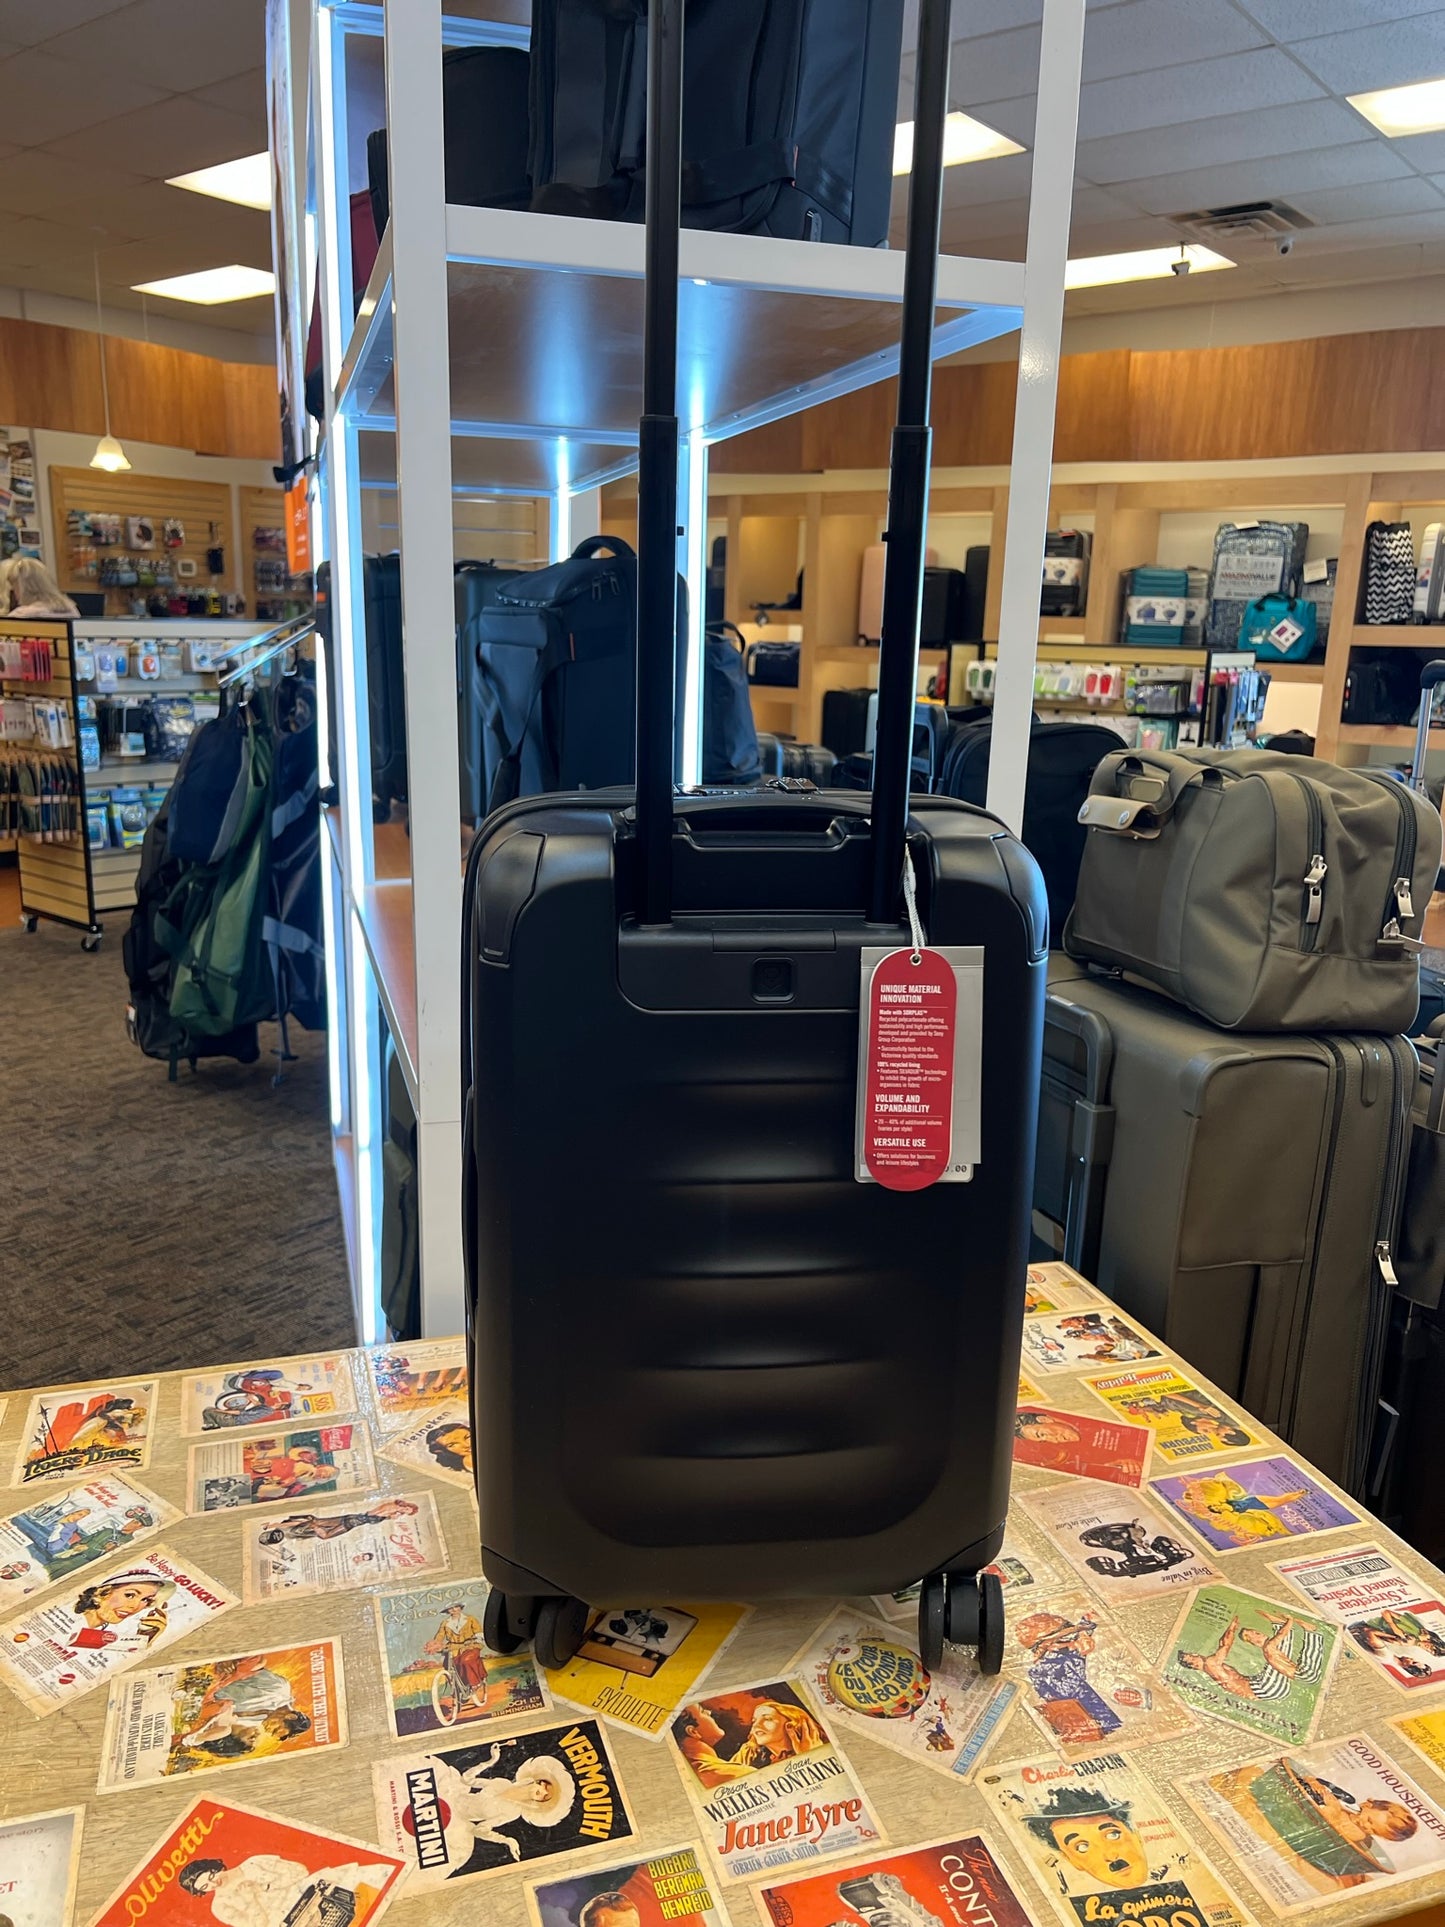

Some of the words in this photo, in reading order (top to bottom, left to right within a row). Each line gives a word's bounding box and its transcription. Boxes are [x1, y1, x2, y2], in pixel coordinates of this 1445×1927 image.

[880, 985, 906, 993] UNIQUE
[908, 985, 942, 993] MATERIAL
[880, 995, 922, 1003] INNOVATION
[875, 1094, 904, 1102] VOLUME
[906, 1095, 920, 1103] AND
[875, 1104, 930, 1113] EXPANDABILITY
[874, 1138, 911, 1147] VERSATILE
[912, 1139, 926, 1147] USE
[1094, 1373, 1138, 1390] Holiday
[1136, 1370, 1174, 1385] Roman
[398, 1411, 452, 1447] Heineken
[1159, 1434, 1210, 1450] HEPBURN
[1171, 1442, 1214, 1456] AUDREY
[1161, 1571, 1185, 1583] Value
[1191, 1566, 1213, 1578] Big
[189, 1582, 227, 1611] LUCKY!
[1361, 1575, 1408, 1595] Named
[1336, 1589, 1402, 1612] Streetcar
[384, 1610, 438, 1624] Cycles
[835, 1663, 854, 1676] LE
[853, 1645, 878, 1673] TOUR
[843, 1677, 866, 1691] DU
[865, 1649, 896, 1688] MONDE
[312, 1673, 326, 1697] WITH
[853, 1692, 877, 1704] EN
[874, 1684, 900, 1702] 80
[892, 1656, 914, 1689] JOURS
[314, 1698, 328, 1717] THE
[492, 1702, 543, 1718] BIRMINGHAM
[592, 1687, 665, 1730] SYLOUETTE
[1418, 1731, 1443, 1756] RATE
[558, 1727, 614, 1839] VERMOUTH
[1021, 1766, 1075, 1790] Charlie
[1071, 1752, 1127, 1777] CHAPLIN
[388, 1781, 398, 1804] MARTINI
[702, 1785, 765, 1824] WELLES
[771, 1756, 845, 1797] FONTAINE
[1348, 1739, 1382, 1777] GOOD
[1380, 1769, 1445, 1841] HOUSEKEEPI
[392, 1812, 402, 1830] ROSSI
[407, 1771, 446, 1867] MARTINI
[718, 1814, 793, 1855] Jane
[794, 1797, 863, 1844] Eyre
[124, 1810, 226, 1924] Olivetti
[648, 1854, 698, 1879] BOGART
[654, 1871, 707, 1899] BERGMAN
[660, 1891, 714, 1920] HENREID
[1084, 1895, 1119, 1922] La
[1121, 1894, 1194, 1918] quimera
